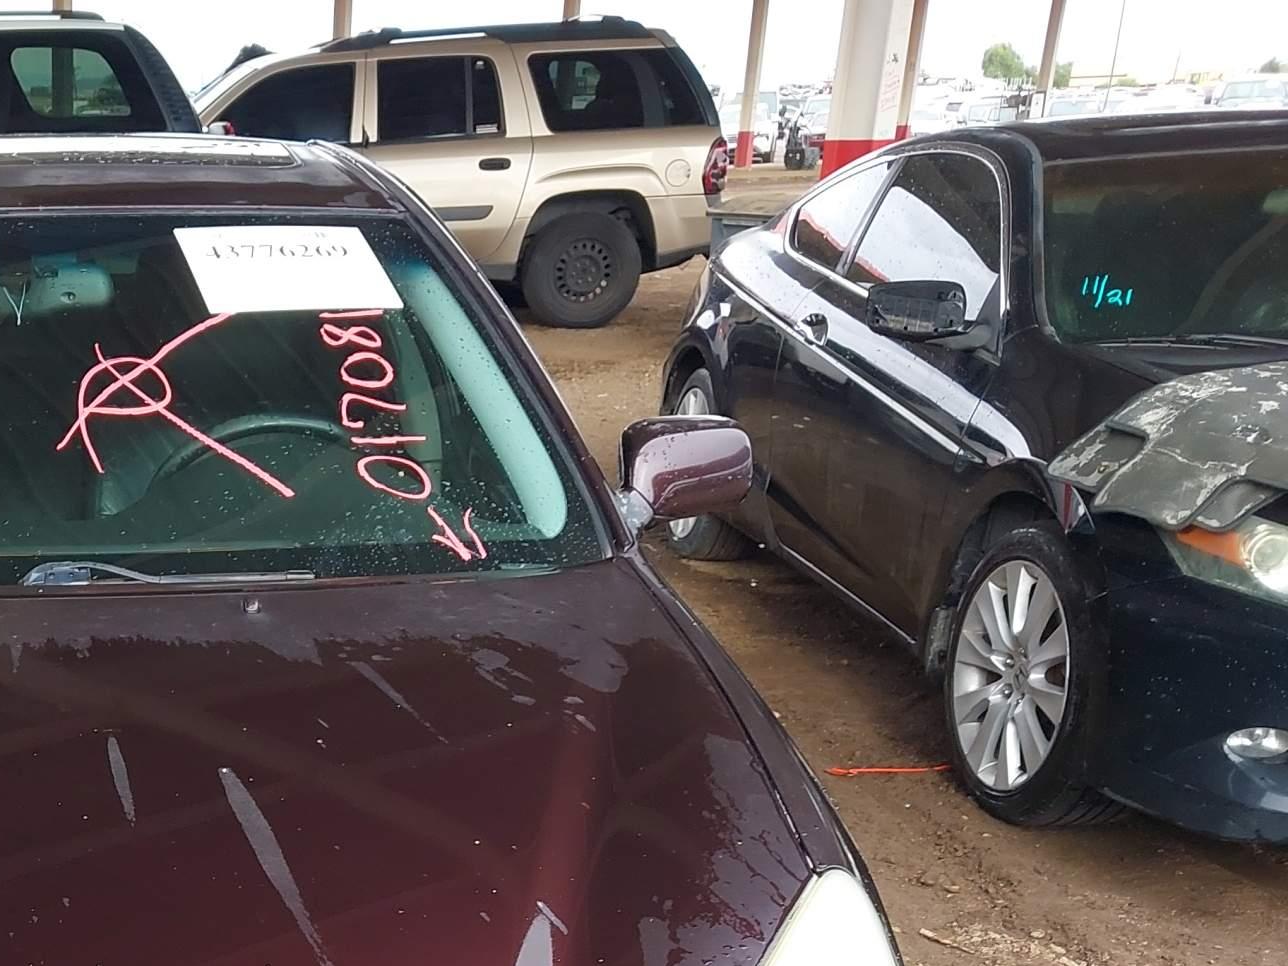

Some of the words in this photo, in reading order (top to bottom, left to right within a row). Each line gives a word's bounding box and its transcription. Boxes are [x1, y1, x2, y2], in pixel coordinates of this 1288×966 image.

[205, 243, 349, 260] 43776269
[1081, 274, 1134, 309] 11/21
[318, 308, 433, 500] 017081
